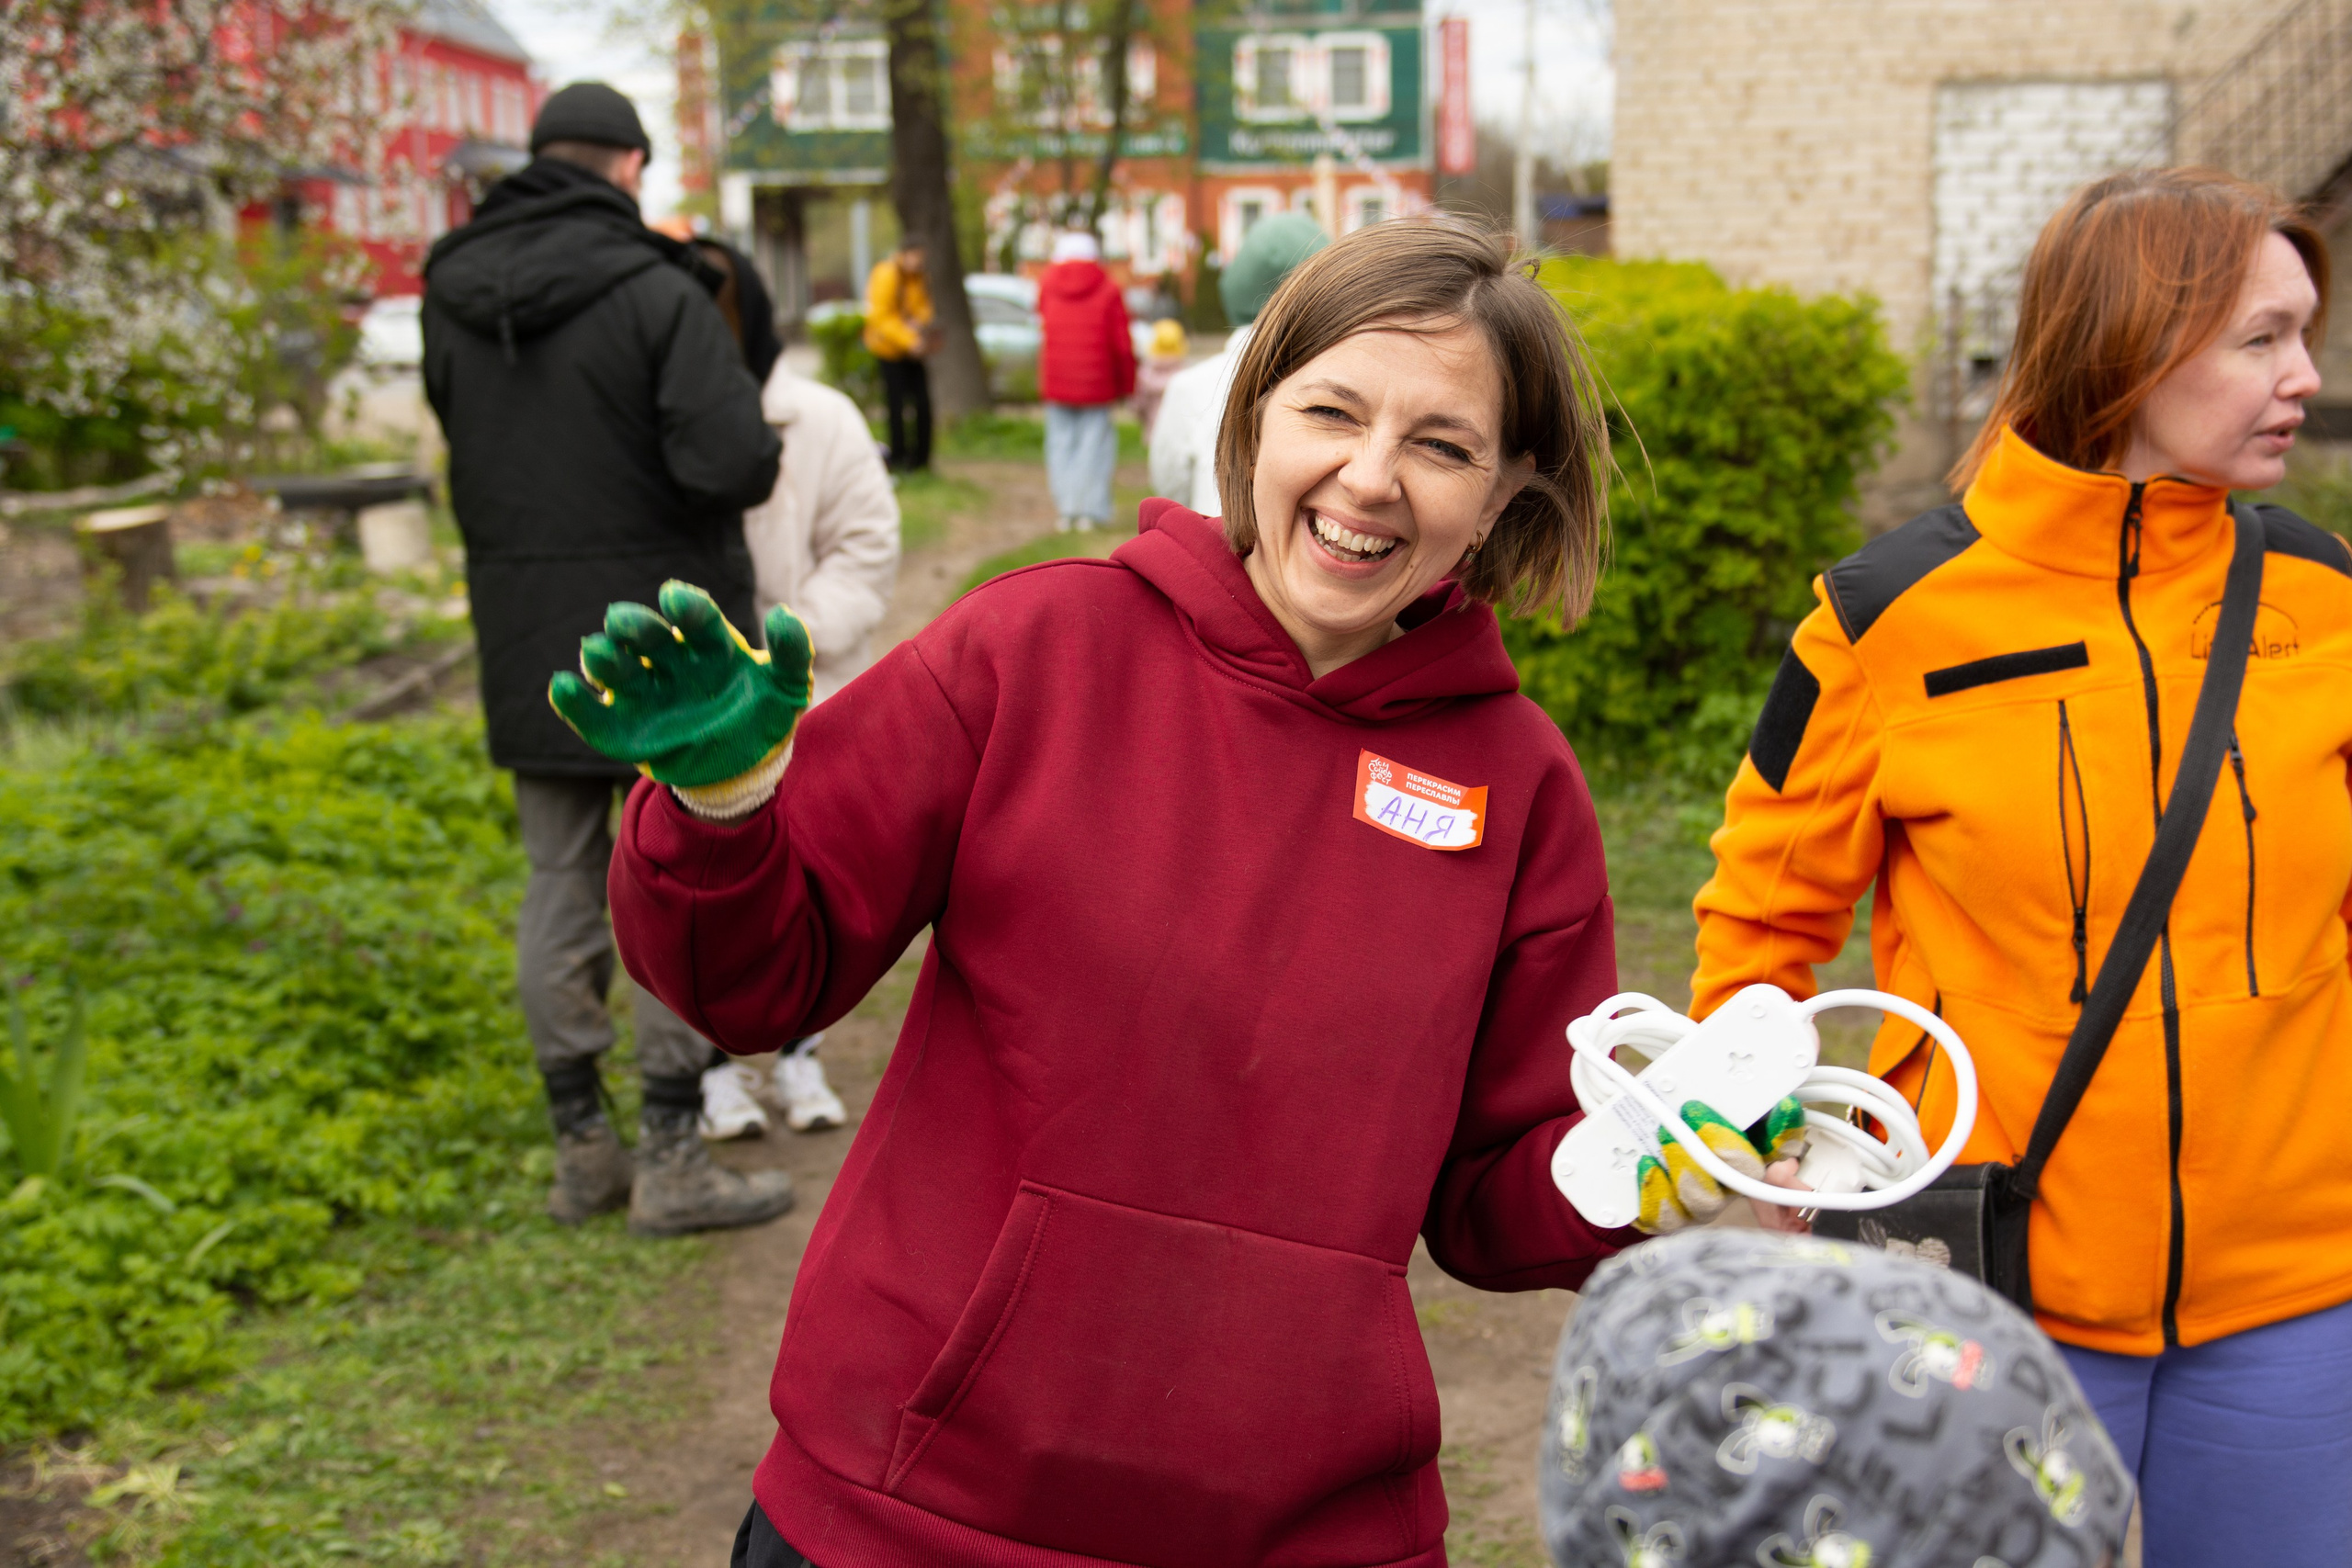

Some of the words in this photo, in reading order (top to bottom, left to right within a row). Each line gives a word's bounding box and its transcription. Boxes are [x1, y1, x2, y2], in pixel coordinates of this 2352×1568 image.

[1406, 782, 1460, 805] ПЕРЕСЛАВЛЬ!
[1407, 773, 1461, 796] ПЕРЕКРАСИМ
[1377, 795, 1456, 841] АНЯ
